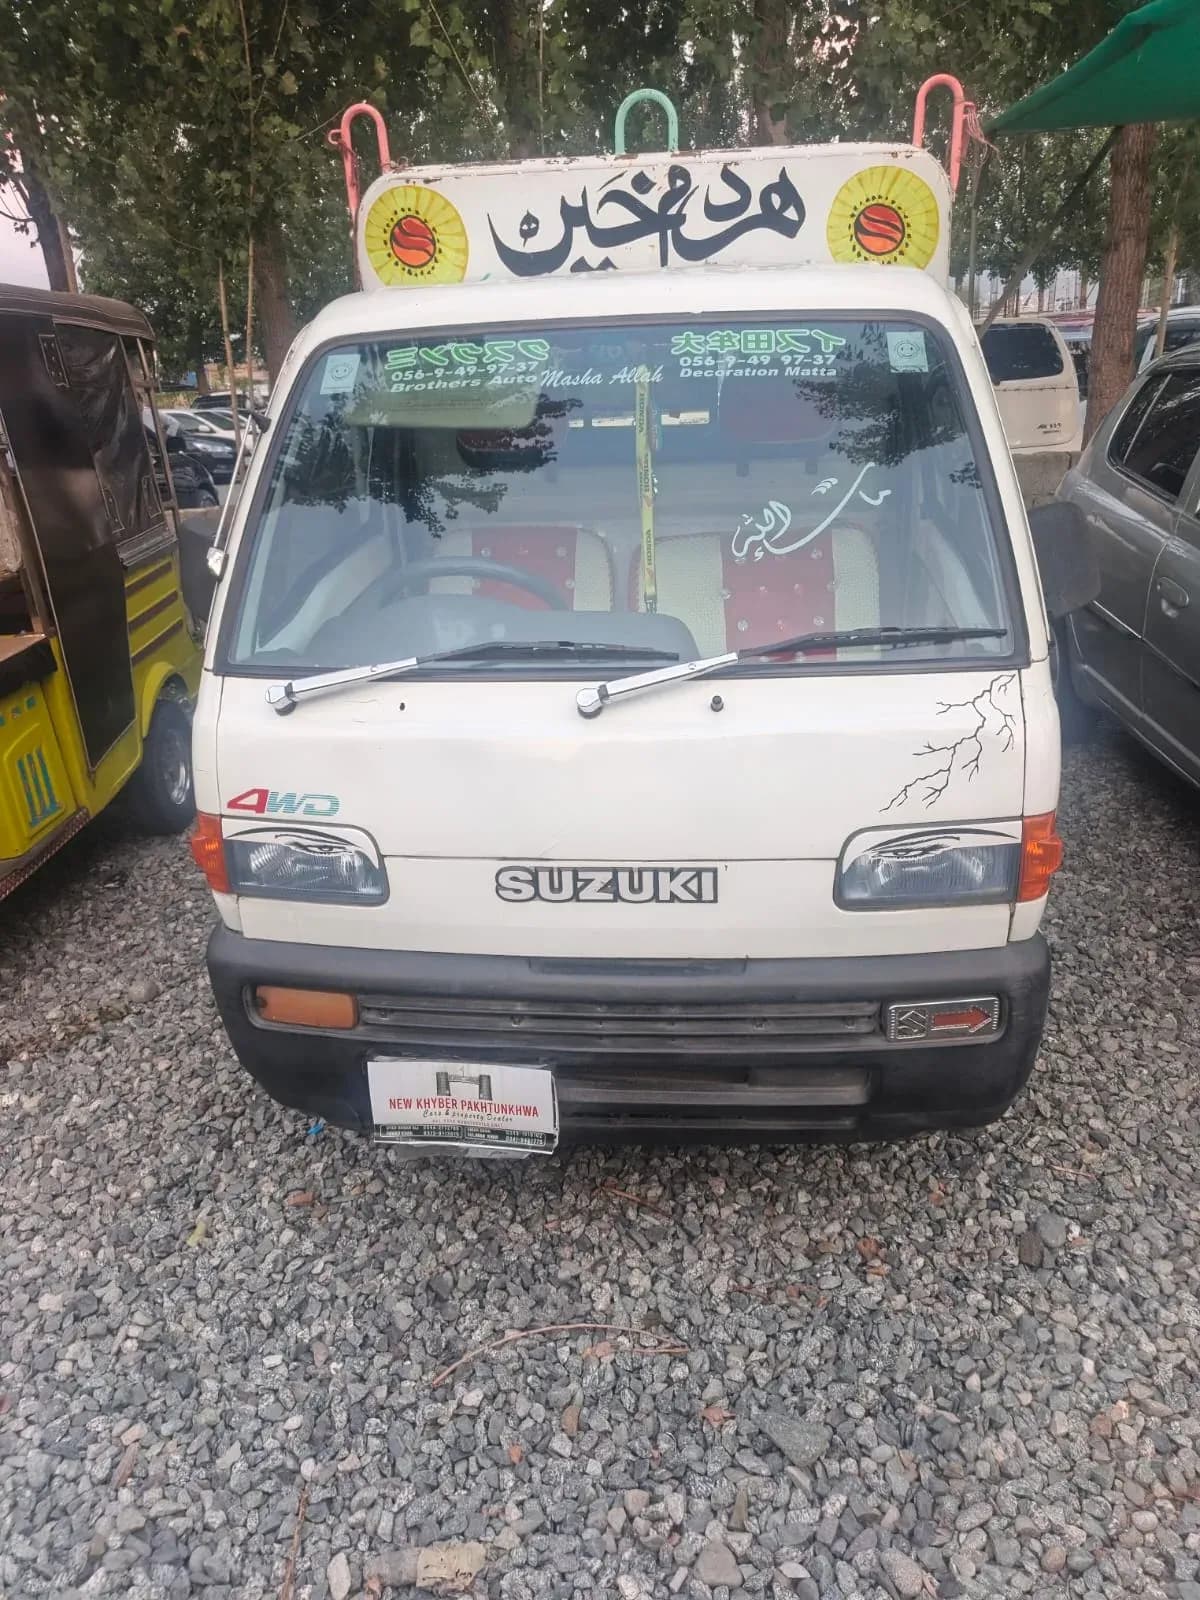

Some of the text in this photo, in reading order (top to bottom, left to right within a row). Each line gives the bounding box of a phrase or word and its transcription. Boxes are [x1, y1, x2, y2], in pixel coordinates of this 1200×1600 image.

[391, 361, 539, 382] 056-9-49-97-37
[540, 364, 664, 388] Masha Allah
[679, 366, 837, 378] Decoration Matta
[391, 374, 538, 393] Brothers Auto
[227, 788, 340, 817] 4WD
[495, 865, 718, 904] SUZUKI
[389, 1097, 539, 1118] NEW KHYBER PAKHTUNKHWA
